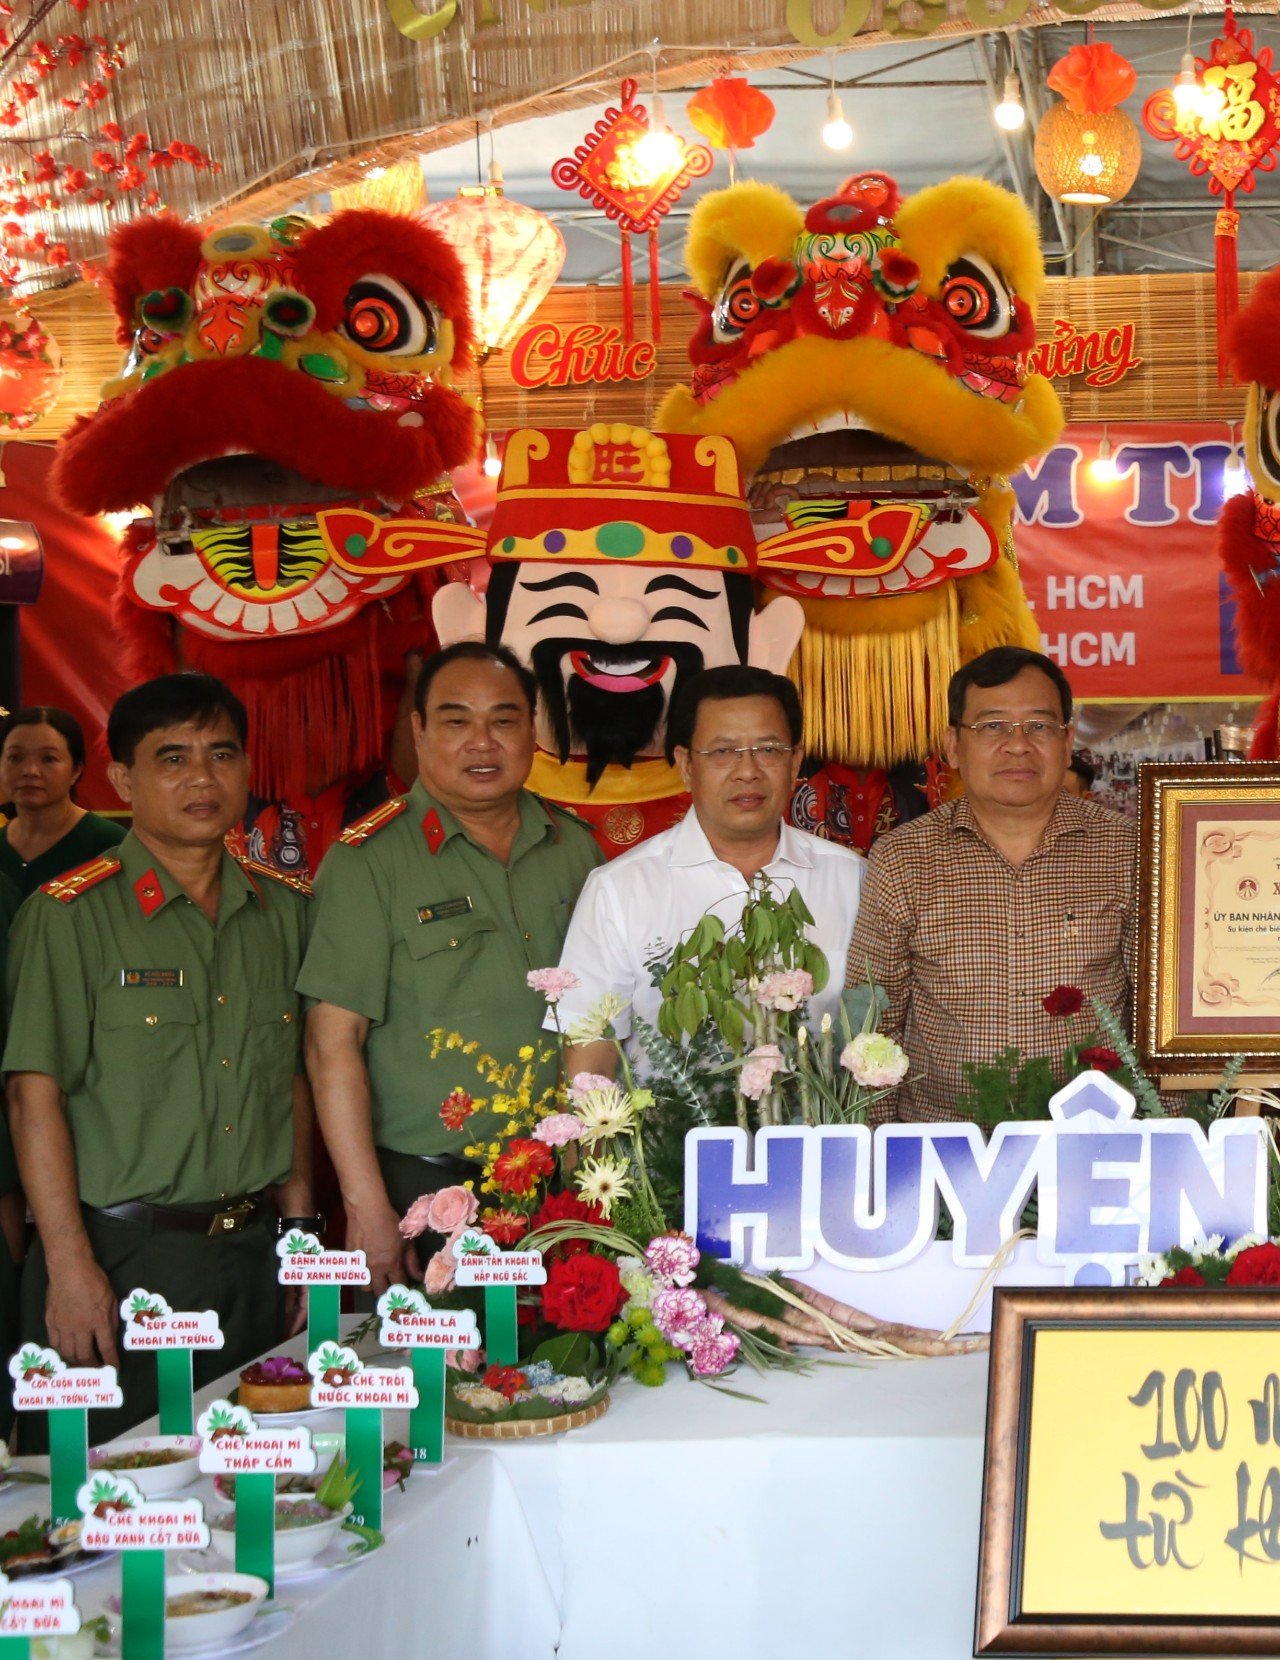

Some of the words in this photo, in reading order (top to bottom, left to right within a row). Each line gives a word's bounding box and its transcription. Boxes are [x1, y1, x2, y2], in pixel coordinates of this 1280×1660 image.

[510, 323, 657, 389] Chúc
[1046, 574, 1144, 610] HCM
[1042, 632, 1136, 667] HCM
[1230, 913, 1250, 921] BAN
[1252, 911, 1280, 921] NHÂN
[688, 1074, 1265, 1286] HUYỆN
[291, 1255, 316, 1265] BÁNH
[319, 1256, 347, 1265] KHOAI
[351, 1254, 360, 1265] MÌ
[505, 1256, 529, 1265] KHOAI
[532, 1254, 540, 1265] MÌ
[306, 1272, 331, 1280] XANH
[146, 1320, 167, 1330] SÚP
[171, 1321, 199, 1329] CANH
[402, 1316, 436, 1327] BÁNH
[131, 1336, 162, 1345] KHOAI
[166, 1334, 176, 1344] MÌ
[387, 1331, 412, 1344] BỘT
[417, 1334, 453, 1343] KHOAI
[458, 1333, 471, 1344] MÌ
[353, 1373, 374, 1386] CHÈ
[18, 1396, 43, 1405] KHOAI
[318, 1389, 351, 1403] NƯỚC
[355, 1392, 392, 1403] KHOAI
[396, 1391, 409, 1403] MÌ
[1128, 1367, 1229, 1459] 100
[216, 1437, 240, 1449] CHÈ
[245, 1440, 283, 1449] KHOAI
[288, 1437, 301, 1449] MÌ
[224, 1454, 260, 1472] THẬP
[139, 1513, 178, 1525] KHOAI
[183, 1510, 197, 1525] MÌ
[1099, 1469, 1209, 1570] từ
[114, 1532, 146, 1545] XANH
